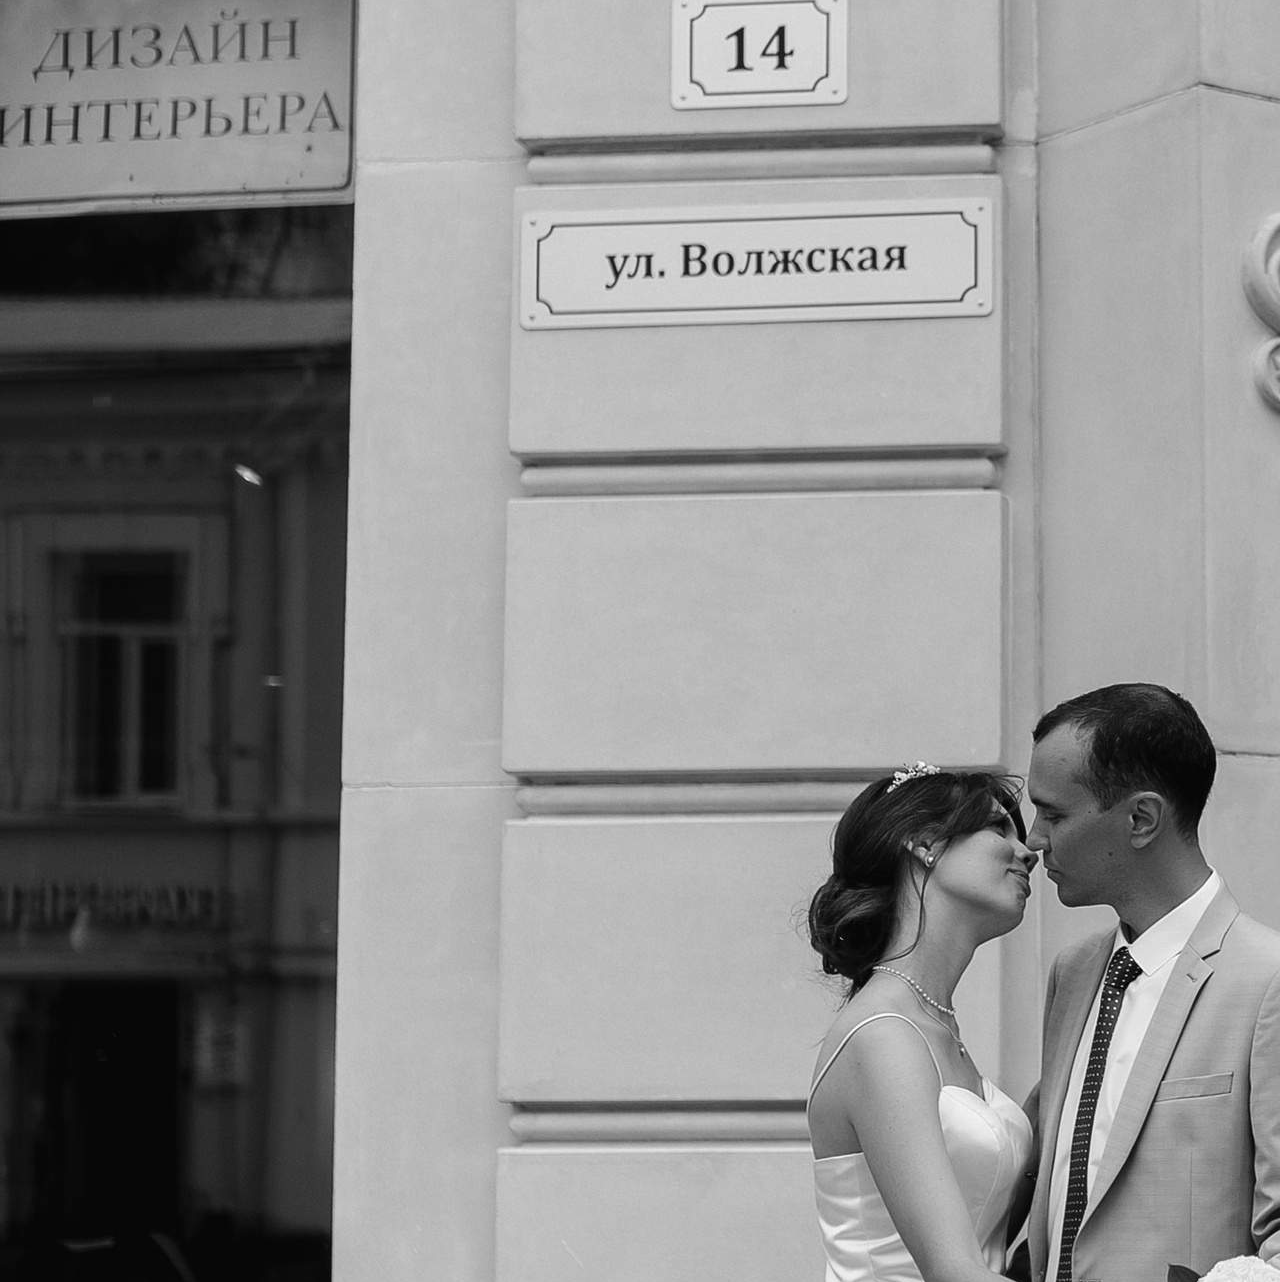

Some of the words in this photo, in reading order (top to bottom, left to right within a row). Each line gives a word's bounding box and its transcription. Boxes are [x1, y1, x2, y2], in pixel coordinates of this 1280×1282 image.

[32, 8, 301, 82] ДИЗАЙН
[724, 25, 794, 72] 14
[0, 90, 344, 148] ИНТЕРЬЕРА
[605, 252, 666, 290] ул.
[680, 243, 908, 278] Волжская
